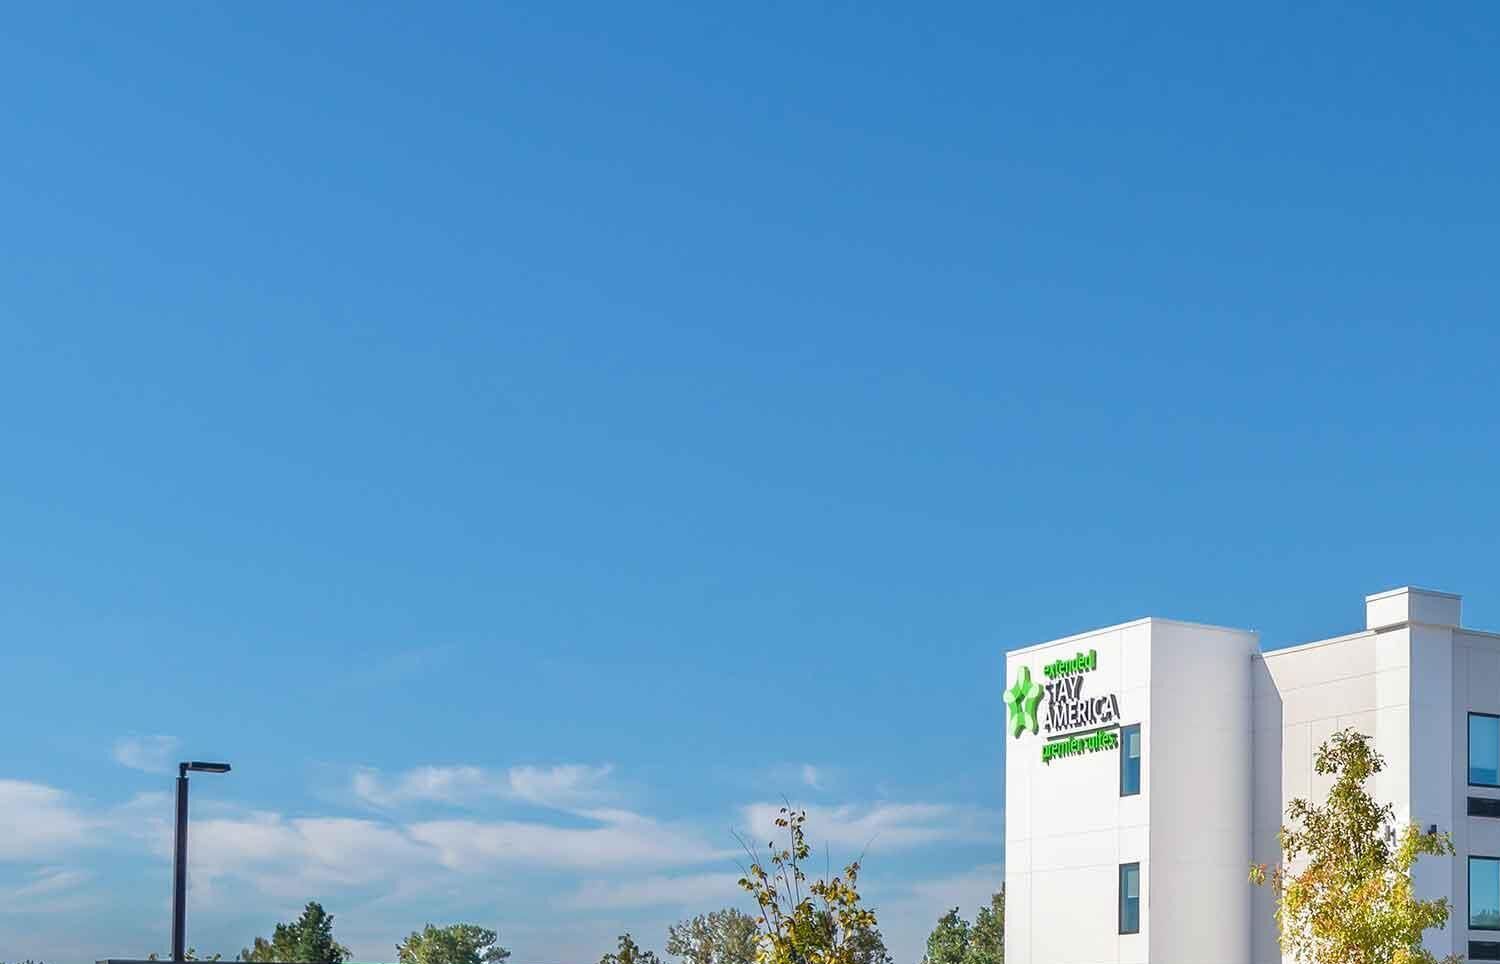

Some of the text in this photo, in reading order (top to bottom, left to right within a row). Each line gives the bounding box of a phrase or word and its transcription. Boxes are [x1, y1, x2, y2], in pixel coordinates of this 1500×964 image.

[1043, 649, 1097, 679] extended
[1043, 693, 1121, 733] AMERICA
[1042, 730, 1120, 766] premier suites
